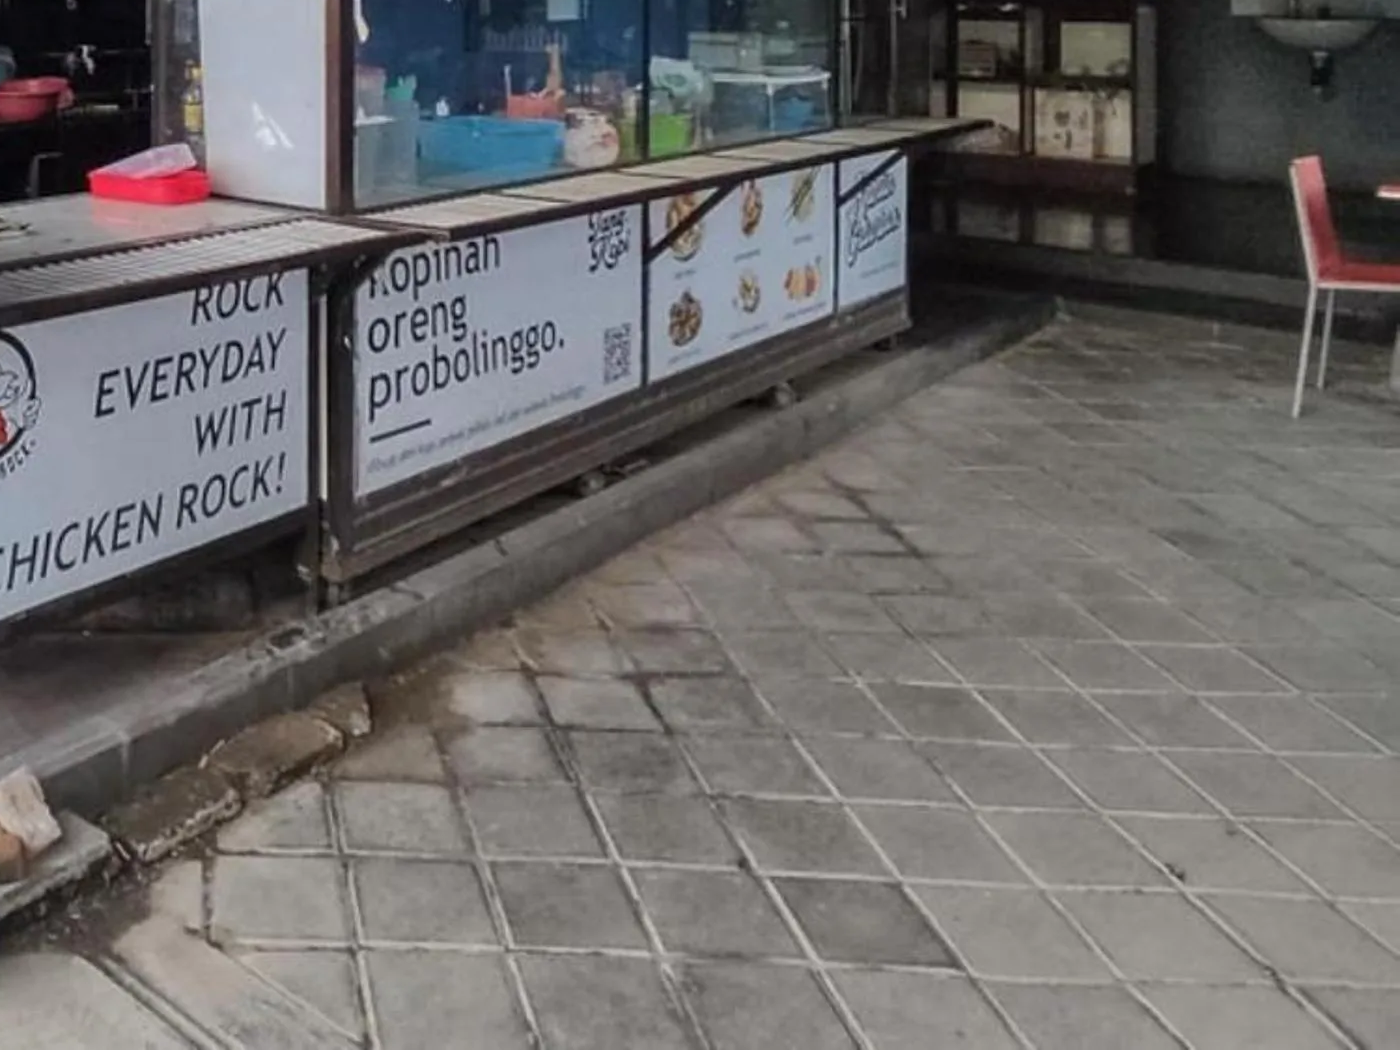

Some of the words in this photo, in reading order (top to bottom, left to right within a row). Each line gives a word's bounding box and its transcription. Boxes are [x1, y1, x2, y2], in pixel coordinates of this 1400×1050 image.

[191, 272, 285, 326] ROCK
[367, 295, 467, 354] oreng
[94, 328, 287, 418] EVERYDAY
[368, 320, 565, 424] probolinggo.
[194, 389, 287, 456] WITH
[176, 452, 287, 530] ROCK!
